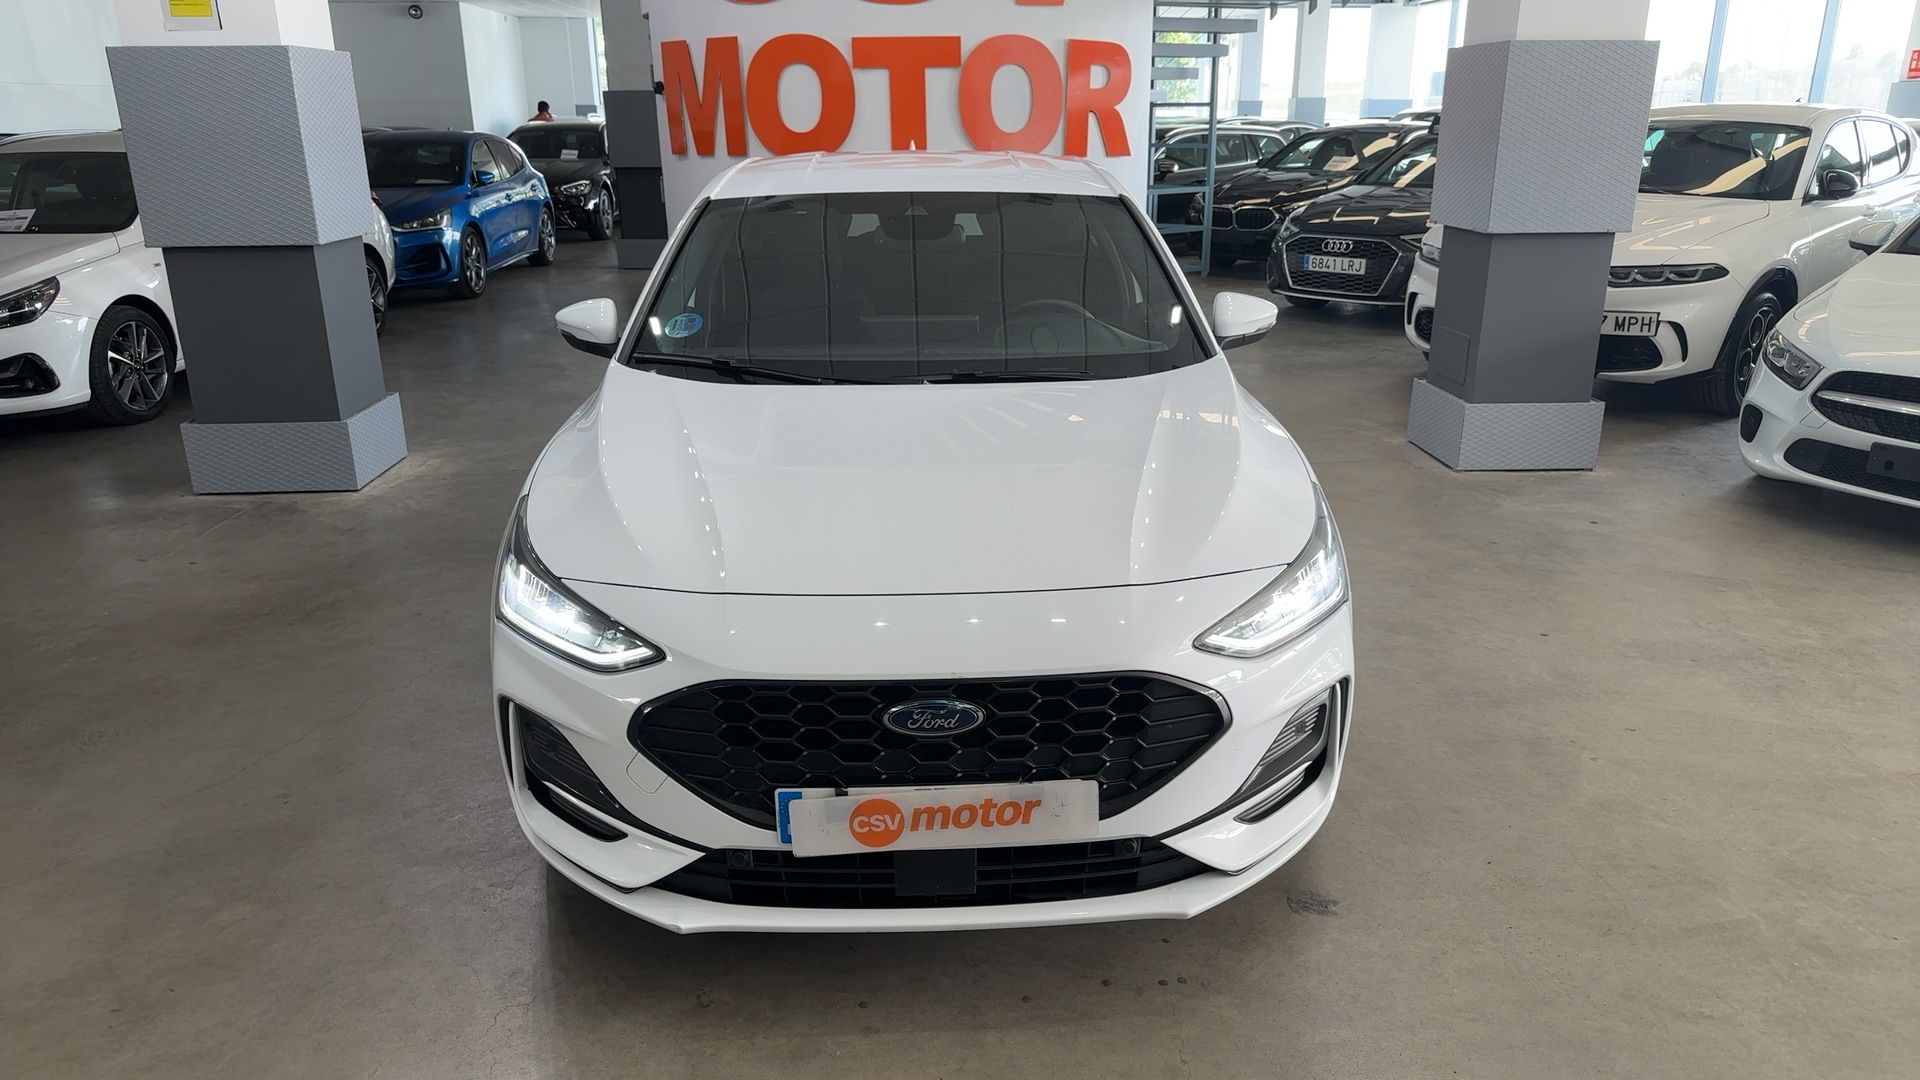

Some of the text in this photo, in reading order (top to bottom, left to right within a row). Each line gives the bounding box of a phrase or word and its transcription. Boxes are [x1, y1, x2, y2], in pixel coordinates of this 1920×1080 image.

[660, 33, 1132, 156] MOTOR
[1311, 257, 1362, 273] 6841 LRJ
[1614, 315, 1653, 333] MPH
[907, 708, 960, 729] Ford
[910, 798, 1042, 832] motor
